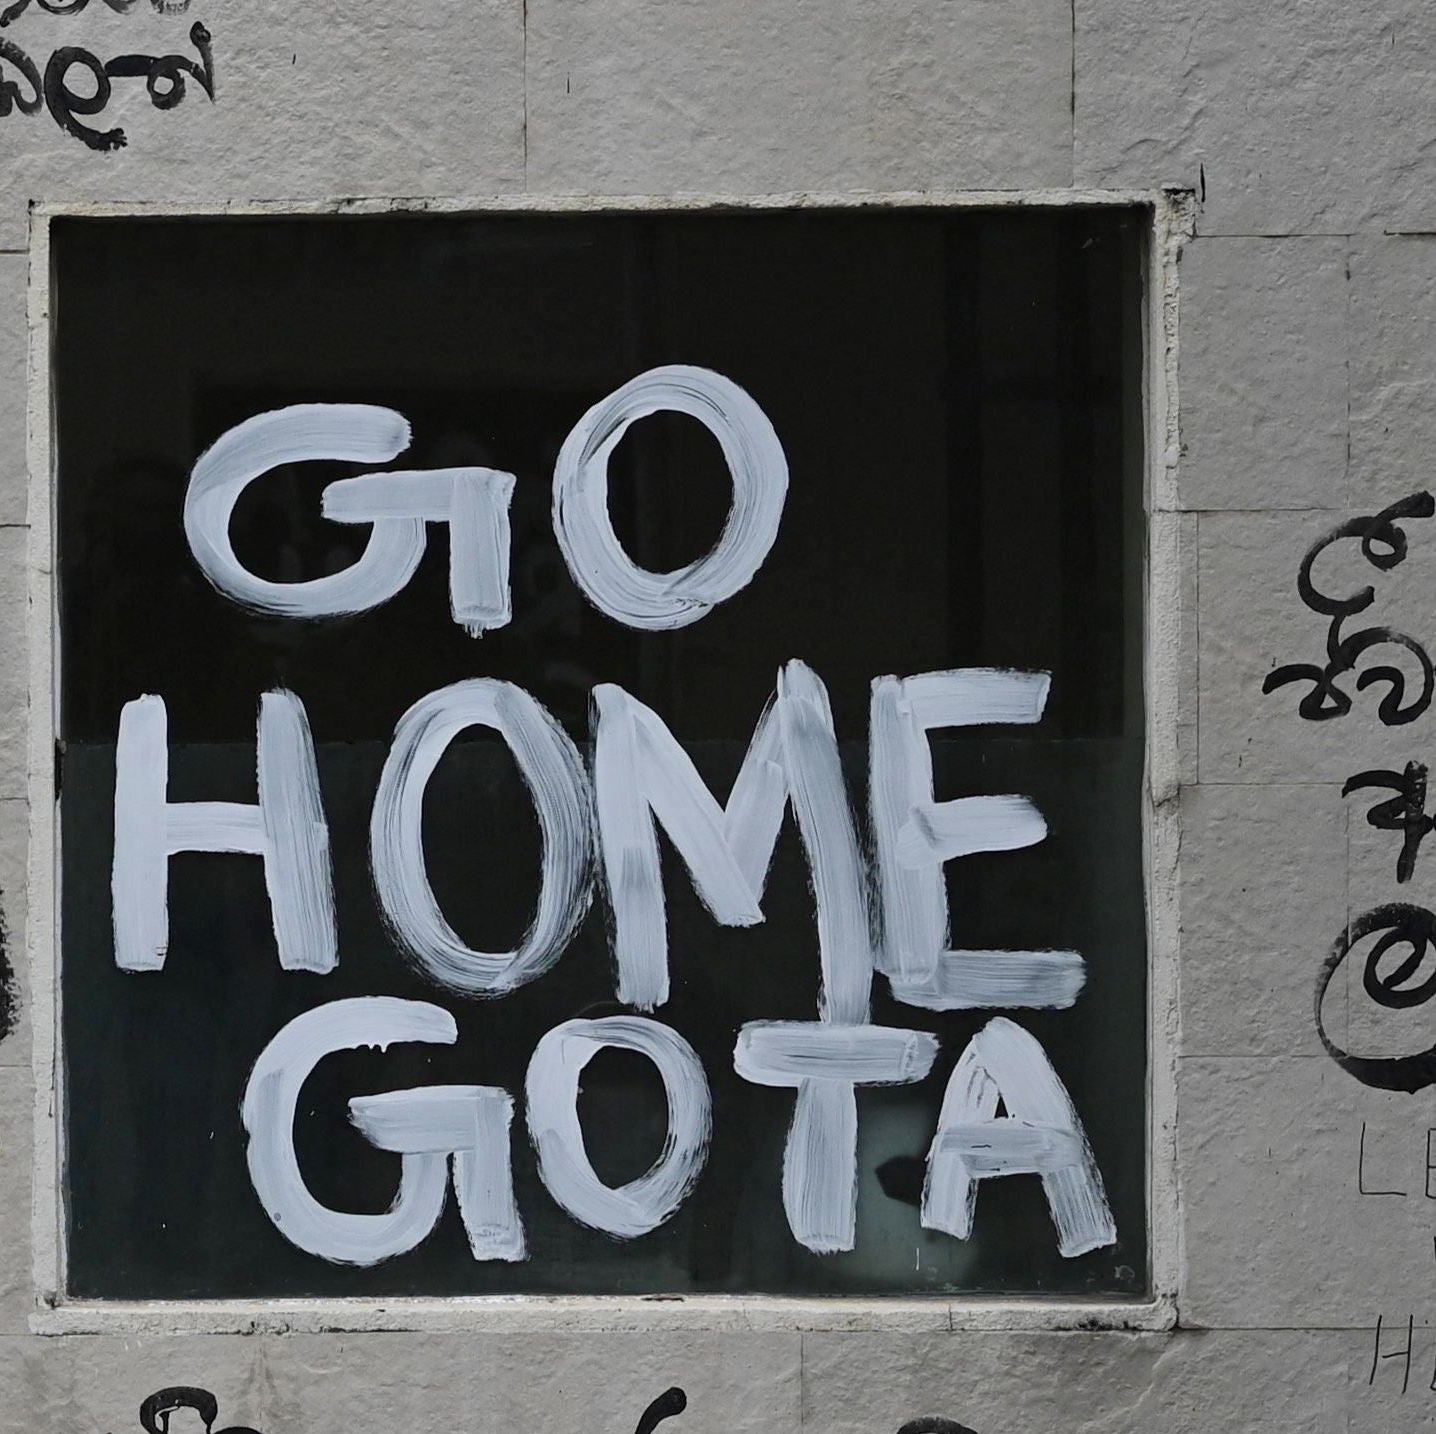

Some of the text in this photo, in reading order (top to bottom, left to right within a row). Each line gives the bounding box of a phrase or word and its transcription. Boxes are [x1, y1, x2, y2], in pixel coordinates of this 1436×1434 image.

[183, 364, 789, 638] GO
[111, 659, 1087, 1022] HOME
[241, 994, 1117, 1266] GOTA
